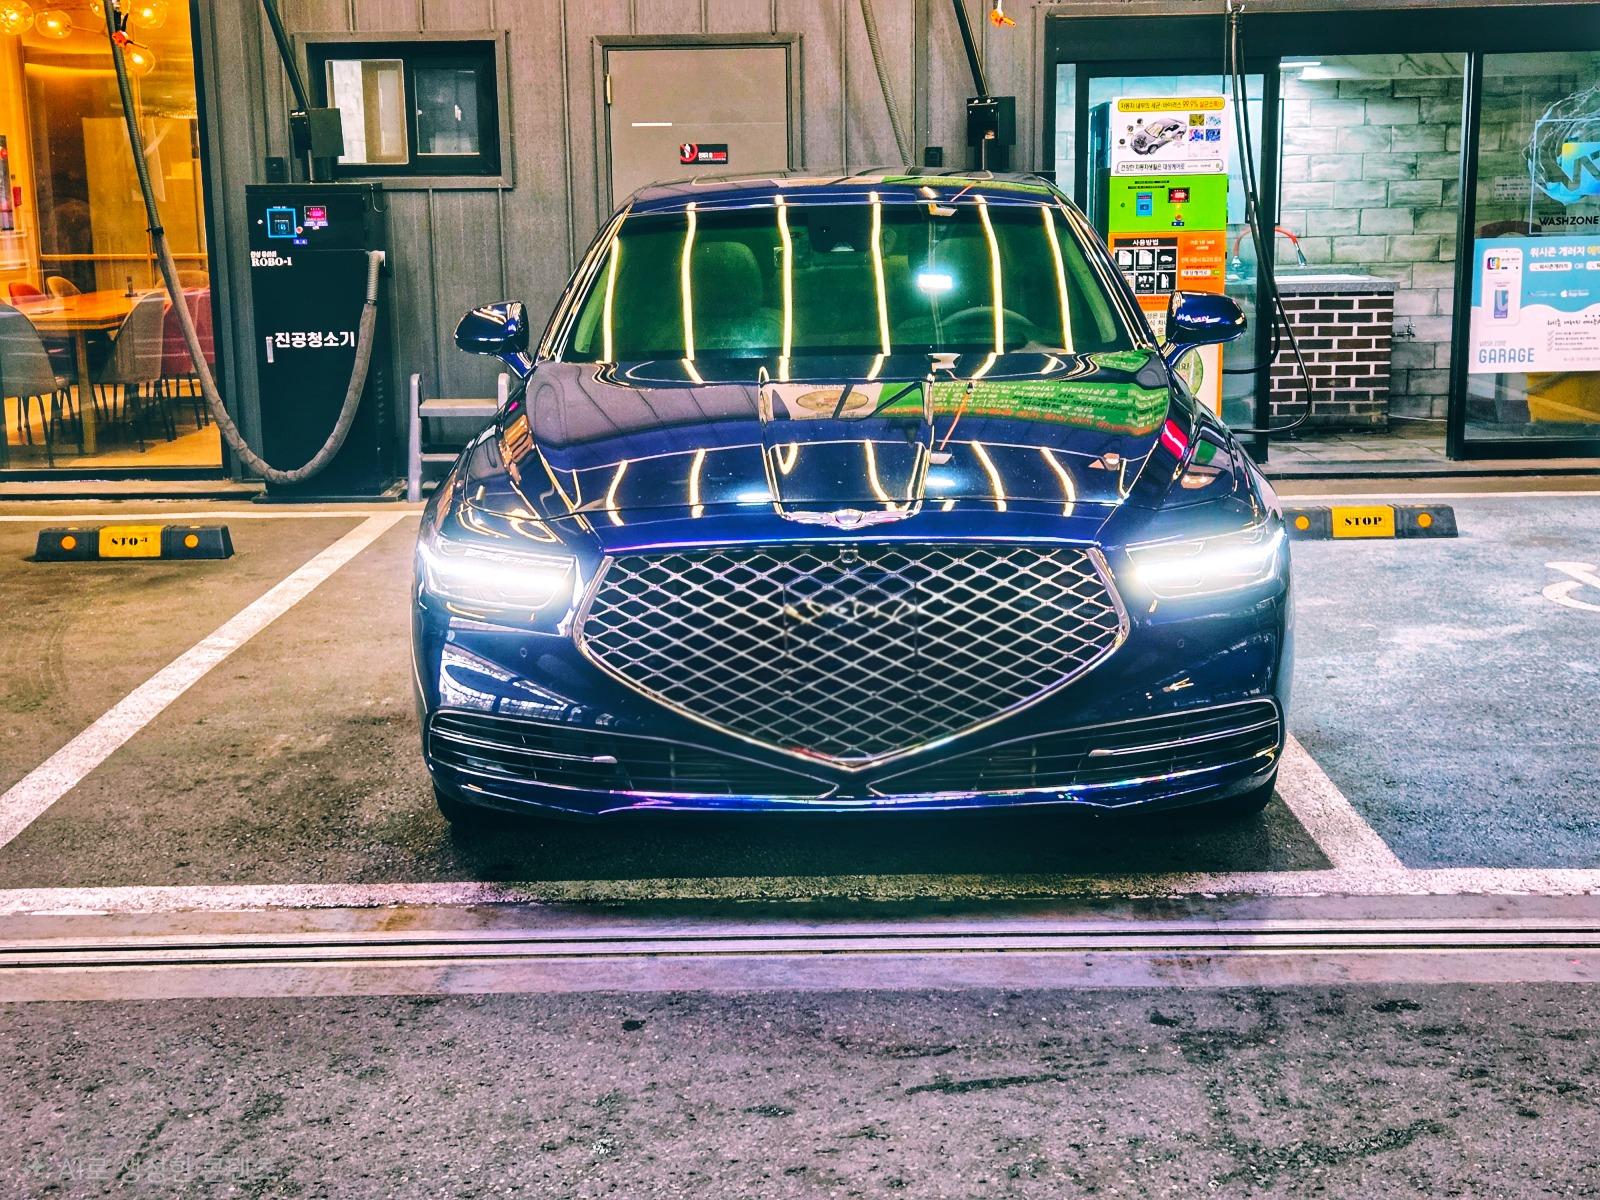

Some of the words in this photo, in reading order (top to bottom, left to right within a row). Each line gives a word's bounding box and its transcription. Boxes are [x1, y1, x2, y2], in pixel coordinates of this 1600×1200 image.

[1539, 216, 1600, 226] WASHZONE
[251, 256, 293, 267] ROBO-1
[274, 331, 356, 348] 진공청소기
[1479, 347, 1535, 364] GARAGE
[1345, 517, 1382, 526] STOP
